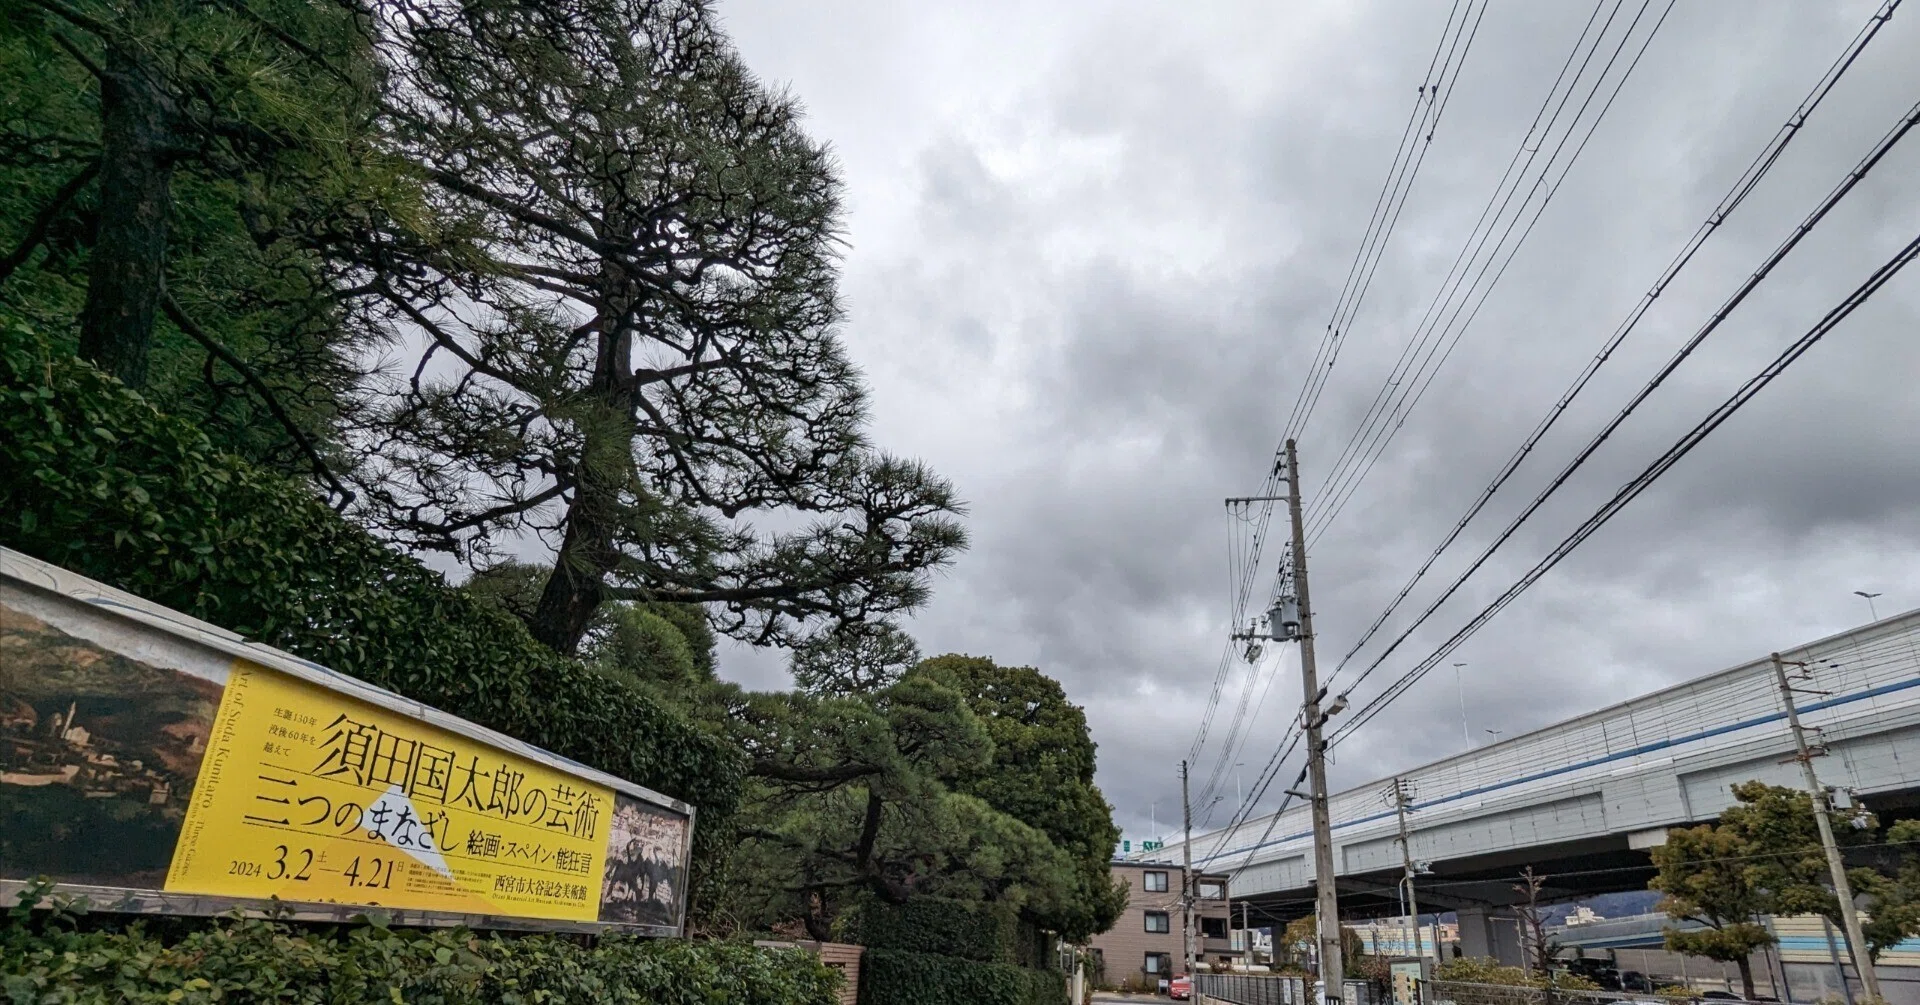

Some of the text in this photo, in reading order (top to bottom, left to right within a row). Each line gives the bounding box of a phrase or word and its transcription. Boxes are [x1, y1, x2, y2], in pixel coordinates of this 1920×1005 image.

[233, 692, 244, 708] of
[221, 709, 241, 742] Suda
[268, 724, 317, 746] 没後60年を
[263, 741, 291, 757] 越えて
[311, 713, 601, 840] 須田国太郎の芸術
[244, 775, 459, 852] 三つのまなざし
[228, 860, 262, 878] 2024
[494, 874, 589, 901] 西宮市大谷記念美術館
